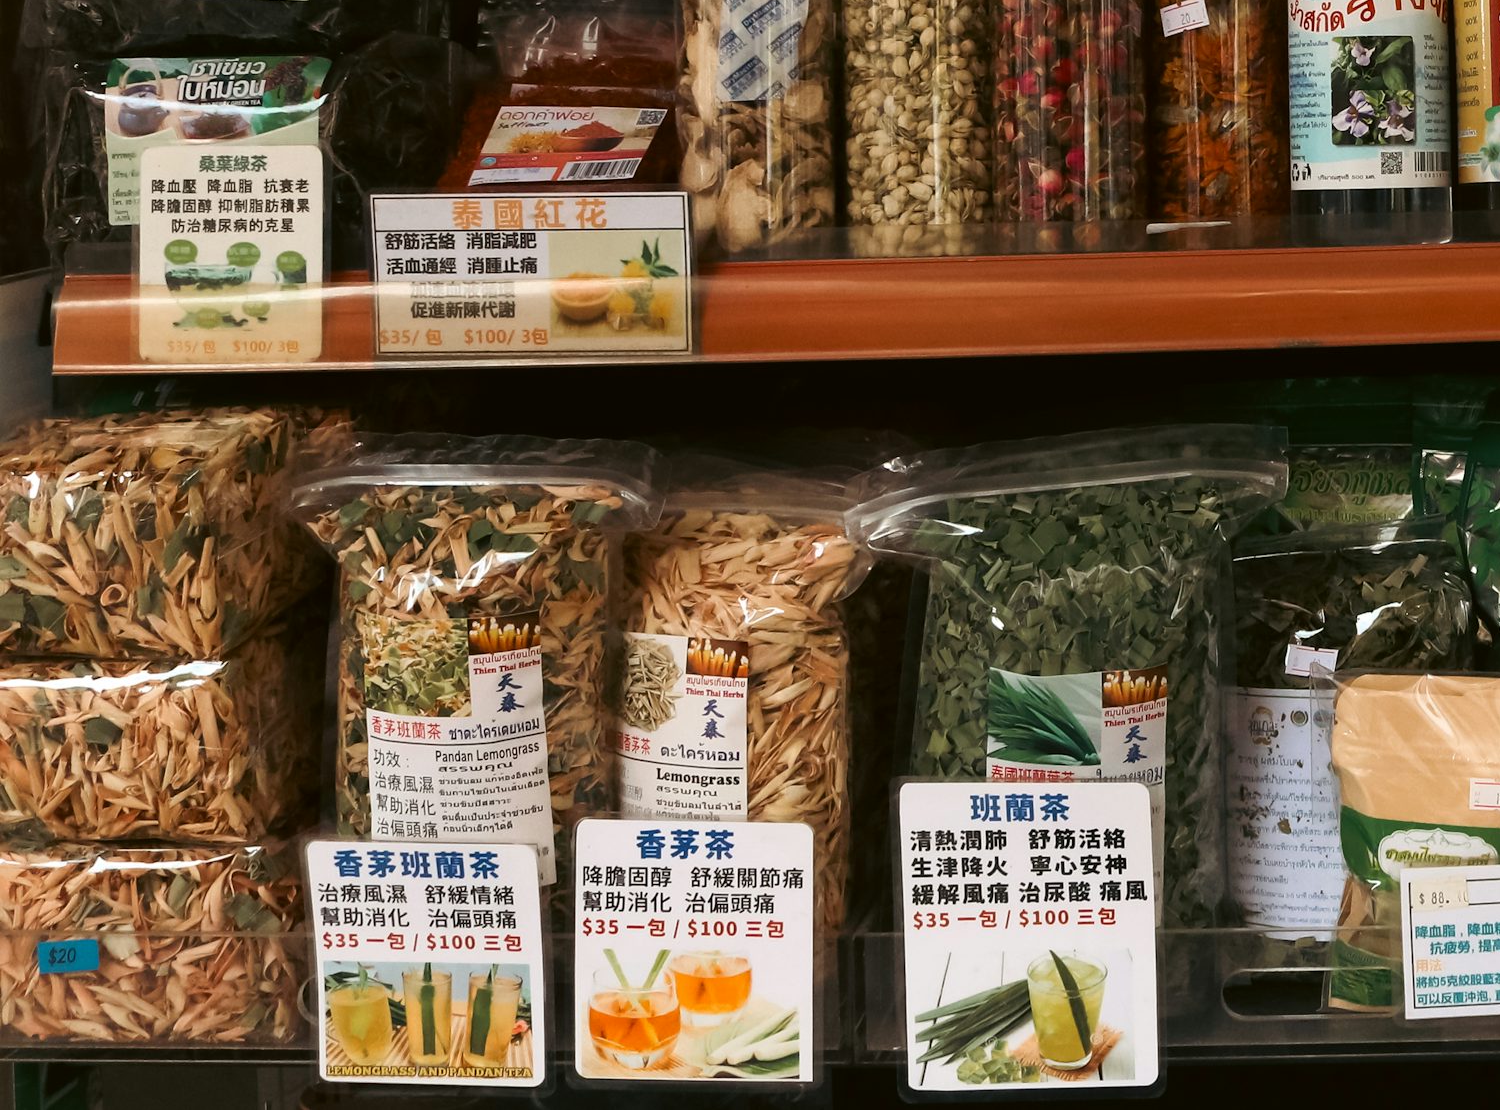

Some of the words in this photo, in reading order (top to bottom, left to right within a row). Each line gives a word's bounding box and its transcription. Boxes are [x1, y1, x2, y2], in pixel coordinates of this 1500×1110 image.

[199, 155, 268, 172] 桑葉綠茶
[151, 179, 197, 193] 降血壓
[207, 179, 253, 193] 降血脂
[264, 179, 309, 193] 抗衰老
[452, 199, 608, 230] 泰國紅花
[171, 218, 295, 233] 防治糖尿病的克星
[385, 232, 456, 251] 舒筋活絡
[466, 232, 537, 250] 消脂減肥
[386, 258, 457, 275] 活血通經
[467, 257, 538, 275] 消腫止痛
[410, 301, 516, 319] 促進新陳代謝
[435, 750, 473, 763] Pandan
[476, 742, 539, 761] Lemongrass
[656, 768, 740, 786] Lemongrass
[970, 793, 1070, 822] 班蘭茶
[636, 829, 735, 860] 香茅茶
[910, 829, 1008, 852] 清熱潤肺
[1028, 828, 1125, 850] 舒筋活絡
[334, 850, 500, 879] 香茅班蘭茶
[318, 884, 408, 904] 治療風濕
[425, 885, 515, 905] 舒緩情緒
[48, 947, 76, 966] $20
[327, 1065, 416, 1077] LEMONGRASS
[418, 1066, 447, 1077] AND
[449, 1067, 504, 1077] PANDAN
[505, 1067, 533, 1078] TEA
